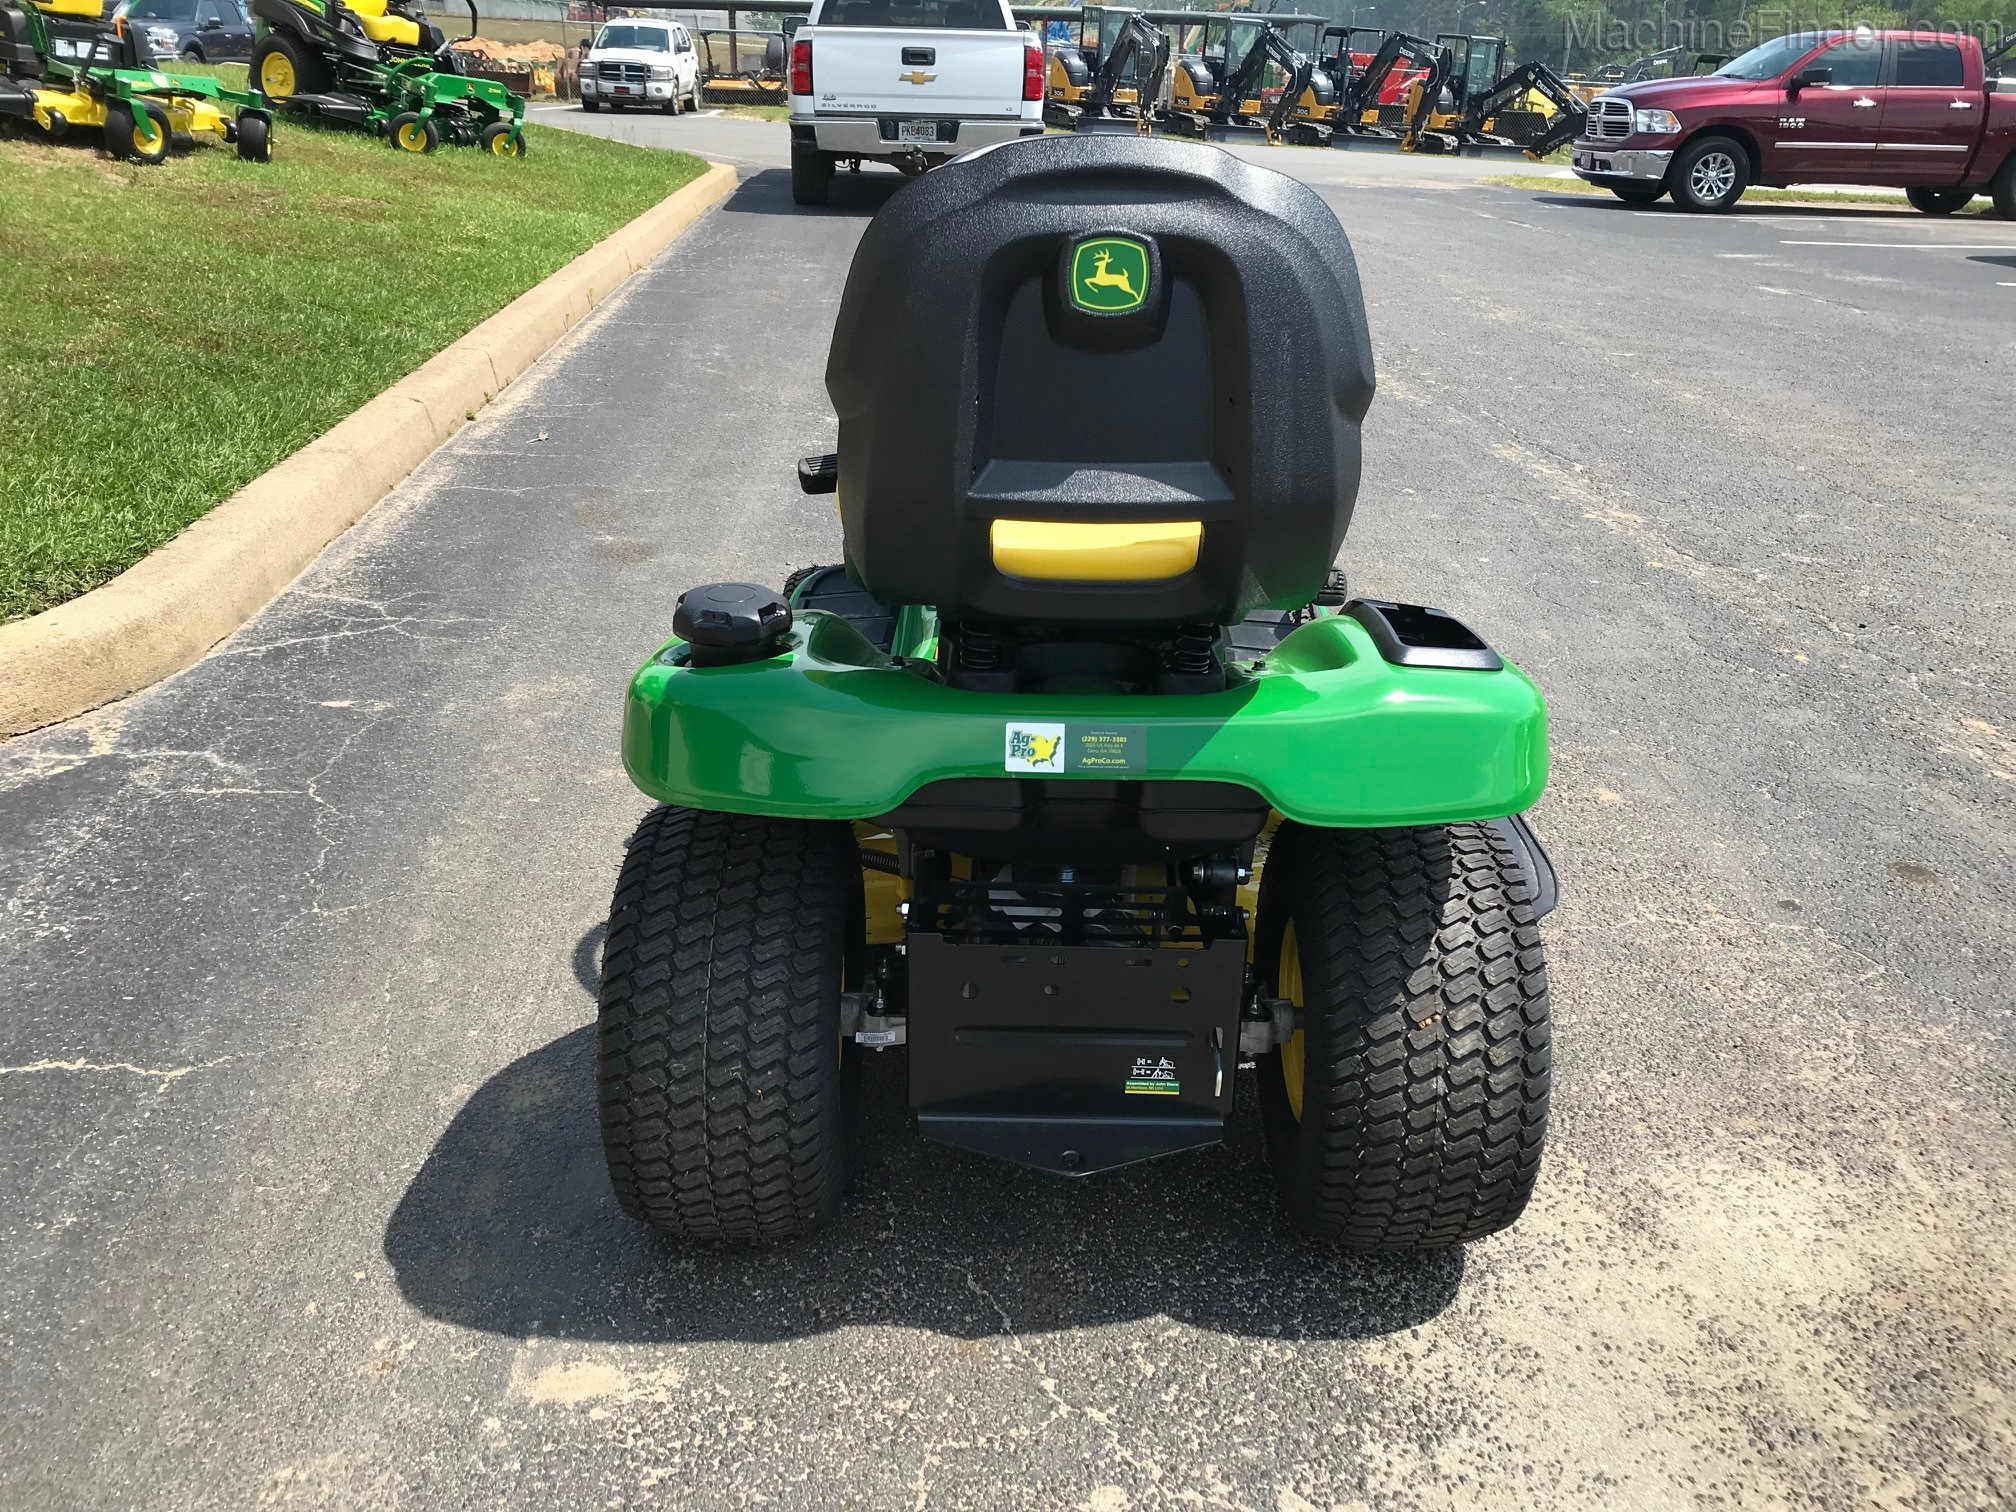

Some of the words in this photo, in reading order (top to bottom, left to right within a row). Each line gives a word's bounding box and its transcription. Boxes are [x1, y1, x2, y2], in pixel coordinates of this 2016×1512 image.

[1399, 46, 1415, 60] DEERE
[1653, 58, 1668, 66] DEERE
[1535, 79, 1554, 98] DEERE
[1009, 730, 1036, 747] Ag-
[1082, 735, 1097, 743] (229)
[1009, 744, 1037, 758] Pro
[1082, 757, 1126, 766] AgProCo.com
